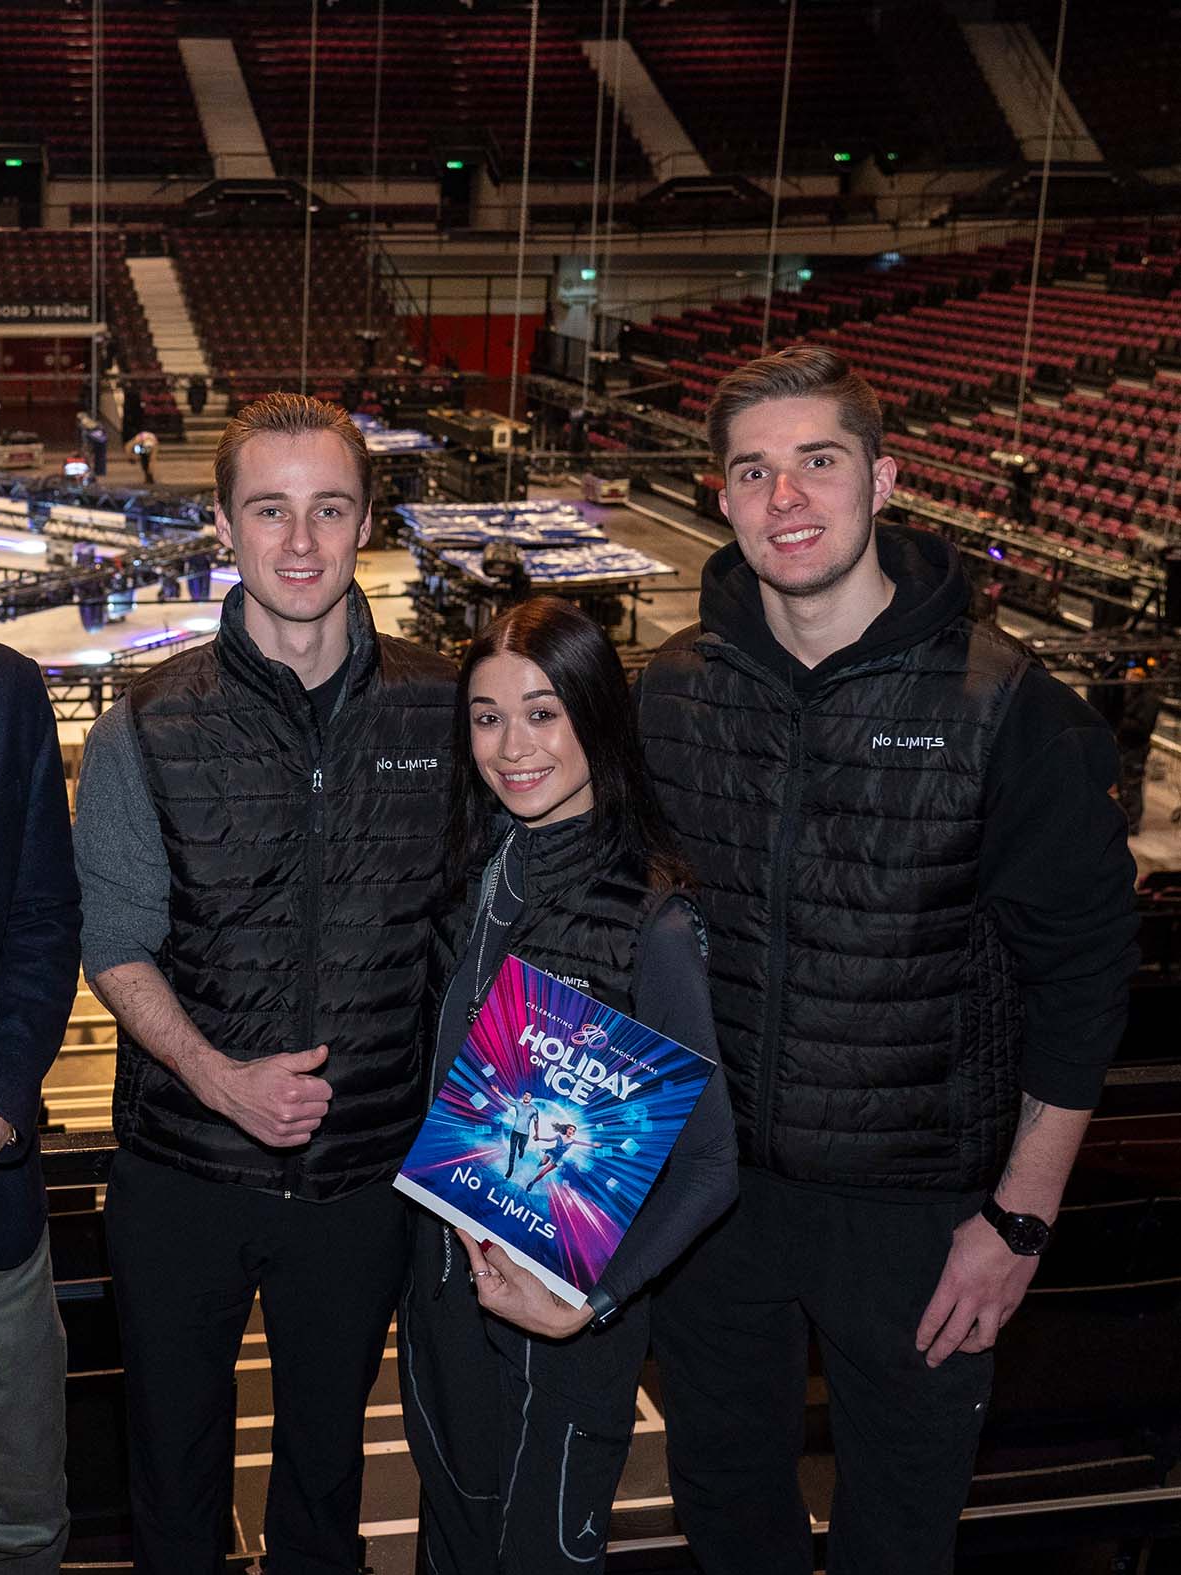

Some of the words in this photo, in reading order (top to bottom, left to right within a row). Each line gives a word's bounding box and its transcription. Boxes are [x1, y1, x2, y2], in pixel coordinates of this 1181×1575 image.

[33, 302, 90, 318] TRIBÜNE
[896, 736, 945, 750] LIMITS
[397, 758, 438, 772] LIMITS
[556, 974, 590, 988] LIMITS
[525, 1001, 574, 1030] CELEBRATING
[571, 1023, 609, 1050] 80
[609, 1045, 638, 1064] MAGICAL
[639, 1061, 659, 1076] YEARS
[518, 1023, 642, 1101] HOLIDAY
[529, 1054, 548, 1070] ON
[544, 1064, 594, 1106] ICE
[486, 1187, 557, 1239] LIMITS
